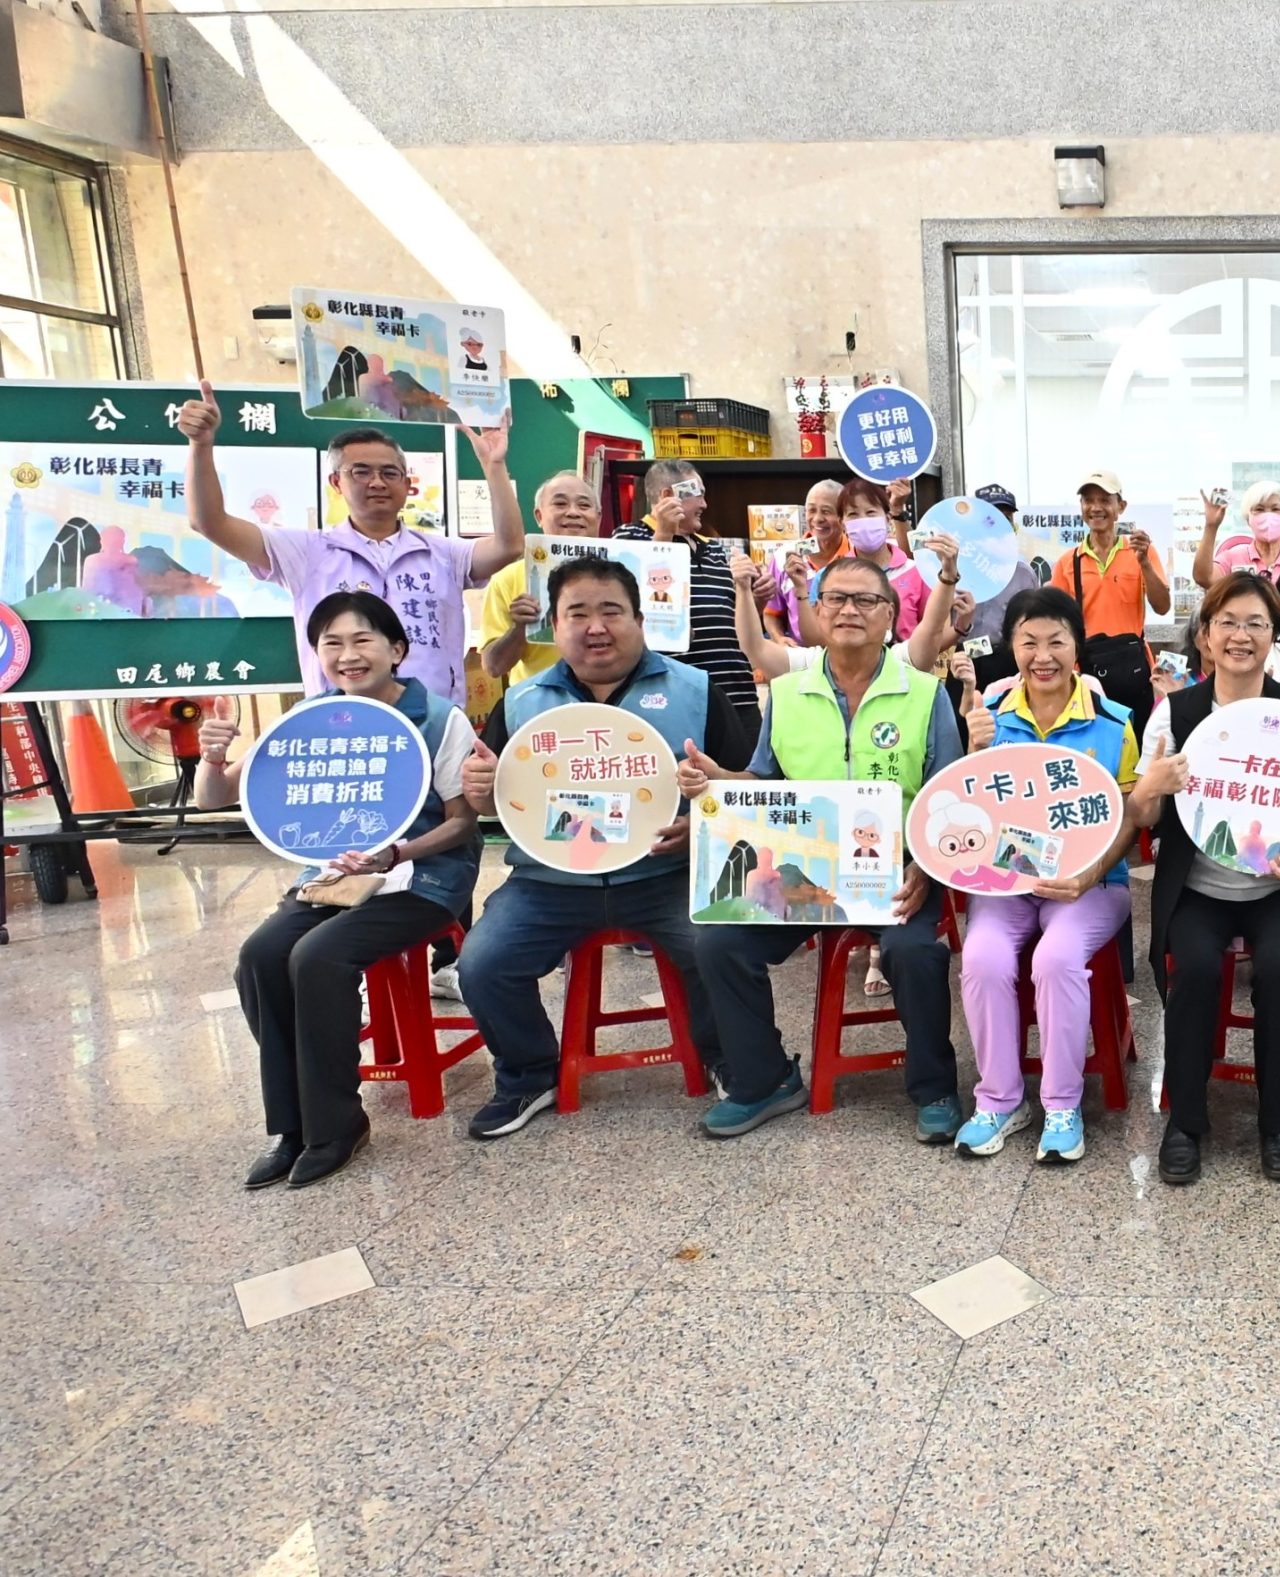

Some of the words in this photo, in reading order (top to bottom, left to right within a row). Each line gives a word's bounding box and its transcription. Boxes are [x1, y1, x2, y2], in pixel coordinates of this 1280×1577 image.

[327, 299, 404, 321] 彰化縣長青
[376, 321, 420, 338] 幸福卡
[857, 406, 909, 431] 更好用
[862, 427, 914, 451] 更便利
[50, 457, 162, 476] 彰化縣長青
[867, 446, 918, 471] 更幸福
[119, 480, 185, 499] 幸福卡
[1022, 514, 1084, 528] 彰化縣長青
[396, 573, 428, 645] 陳建誌
[116, 660, 256, 684] 田尾鄉農會
[267, 735, 408, 757] 彰化長青幸福卡
[286, 757, 387, 778] 特約農漁會
[570, 755, 657, 781] 就折抵!
[857, 787, 882, 795] 敬老卡
[965, 759, 1078, 801] 「卡」緊
[285, 781, 384, 805] 消費折抵
[723, 791, 797, 807] 彰化縣長青
[768, 810, 812, 825] 幸福卡
[1048, 793, 1110, 830] 來辦
[852, 861, 880, 872] 李小美
